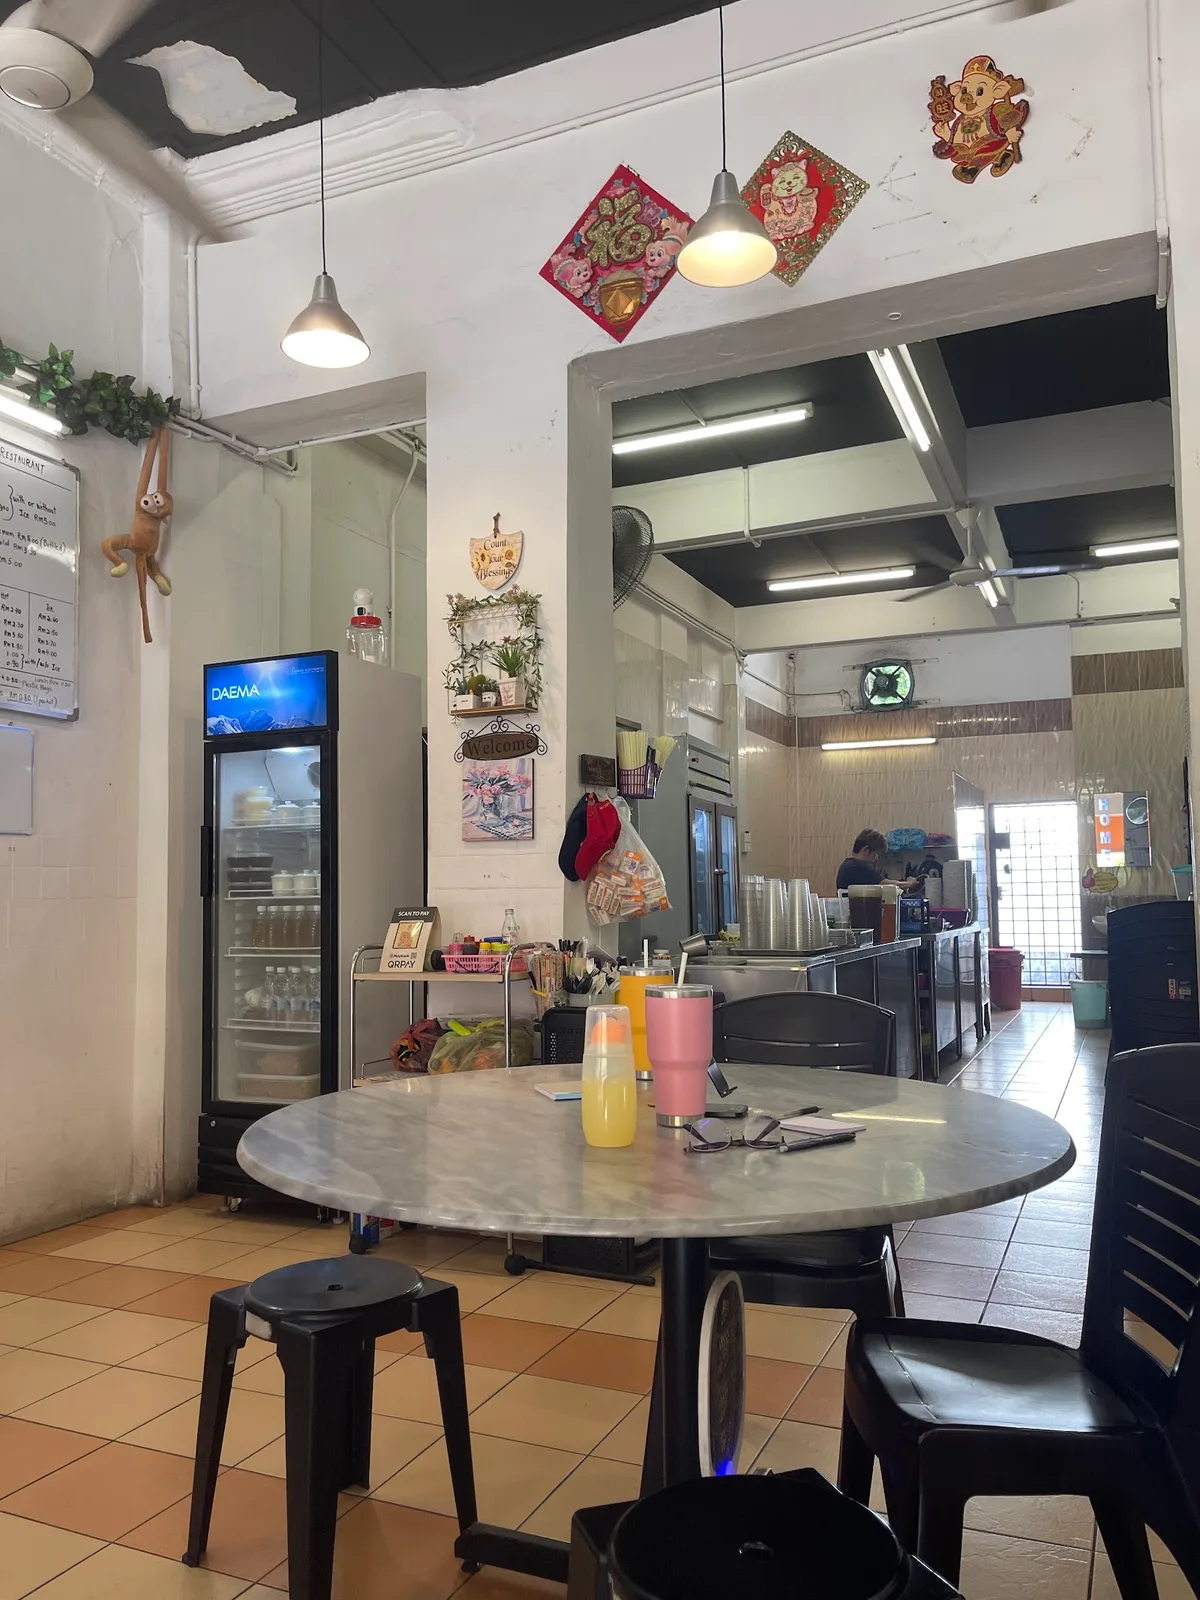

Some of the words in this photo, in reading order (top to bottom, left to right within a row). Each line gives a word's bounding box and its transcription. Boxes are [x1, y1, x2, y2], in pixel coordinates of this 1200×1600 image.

[586, 189, 652, 267] 福
[0, 446, 45, 474] RESTAURANT
[13, 494, 25, 504] with
[36, 502, 57, 515] without
[19, 509, 30, 519] Ice
[484, 540, 506, 550] Count
[487, 553, 503, 564] Your
[476, 567, 513, 580] Blessings
[212, 684, 259, 700] DAEMA
[466, 738, 533, 756] Welcome
[387, 960, 416, 969] QRPAY
